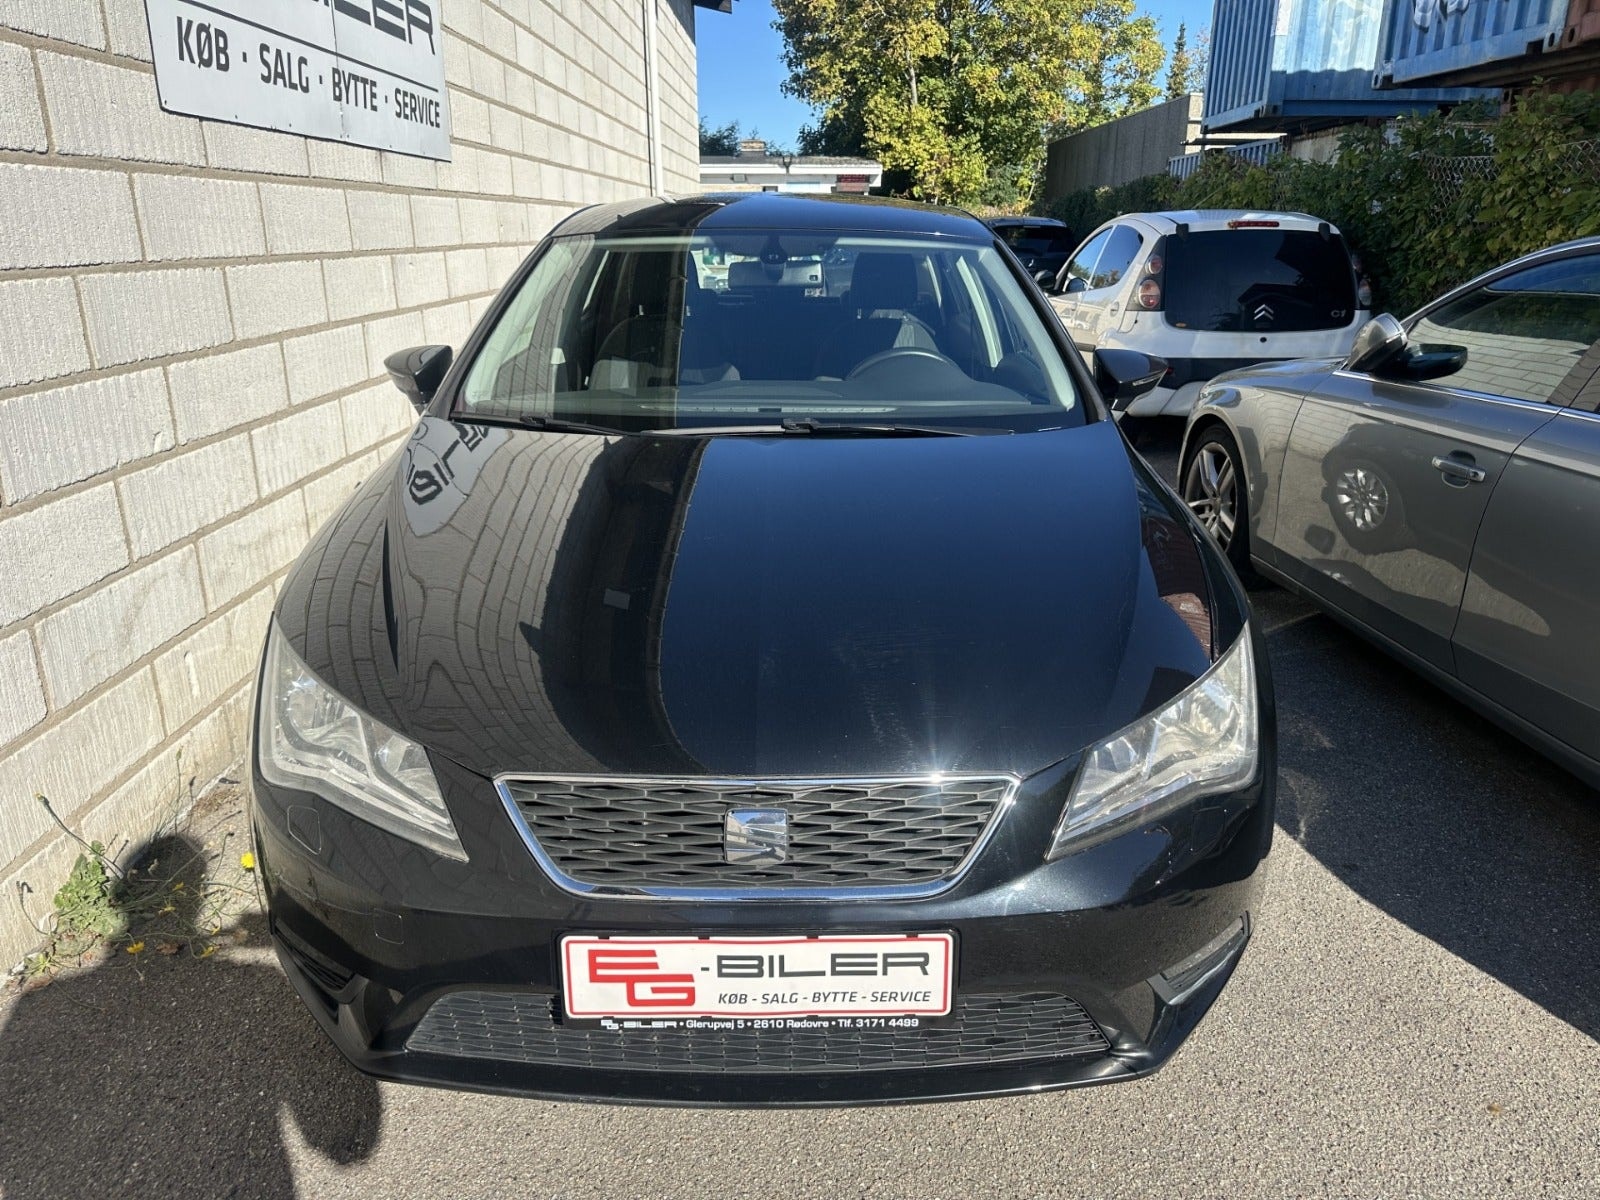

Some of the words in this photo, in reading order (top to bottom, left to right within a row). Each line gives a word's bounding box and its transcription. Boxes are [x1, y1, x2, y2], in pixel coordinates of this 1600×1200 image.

[176, 15, 230, 73] KØB
[258, 42, 310, 94] SALG
[331, 66, 378, 113] BYTTE
[394, 86, 441, 129] SERVICE
[718, 992, 748, 1005] KØB
[761, 992, 799, 1005] SALG
[811, 991, 858, 1003] BYTTE
[870, 990, 932, 1003] SERVICE
[736, 1019, 745, 1029] 5
[753, 1019, 784, 1029] 2610
[855, 1018, 886, 1028] 3171
[888, 1018, 920, 1028] 4499
